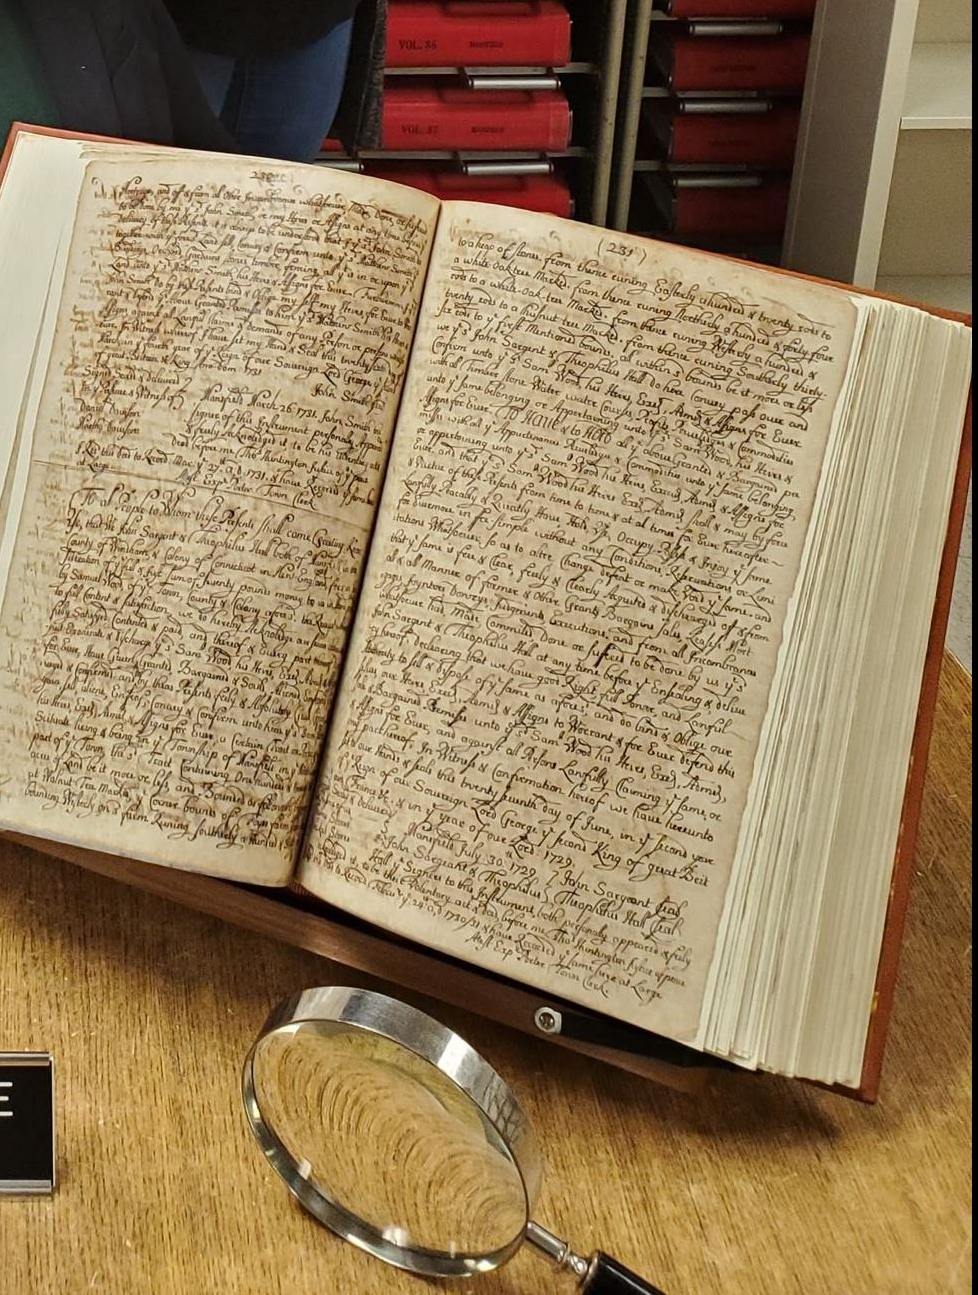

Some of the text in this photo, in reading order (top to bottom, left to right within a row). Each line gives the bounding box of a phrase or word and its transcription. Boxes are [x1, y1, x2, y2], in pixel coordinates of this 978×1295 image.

[399, 41, 423, 50] VOL.
[402, 125, 424, 135] VOL.
[470, 329, 498, 344] John
[318, 409, 343, 425] John
[501, 809, 538, 837] George
[456, 841, 536, 877] July 1729
[592, 840, 622, 870] King
